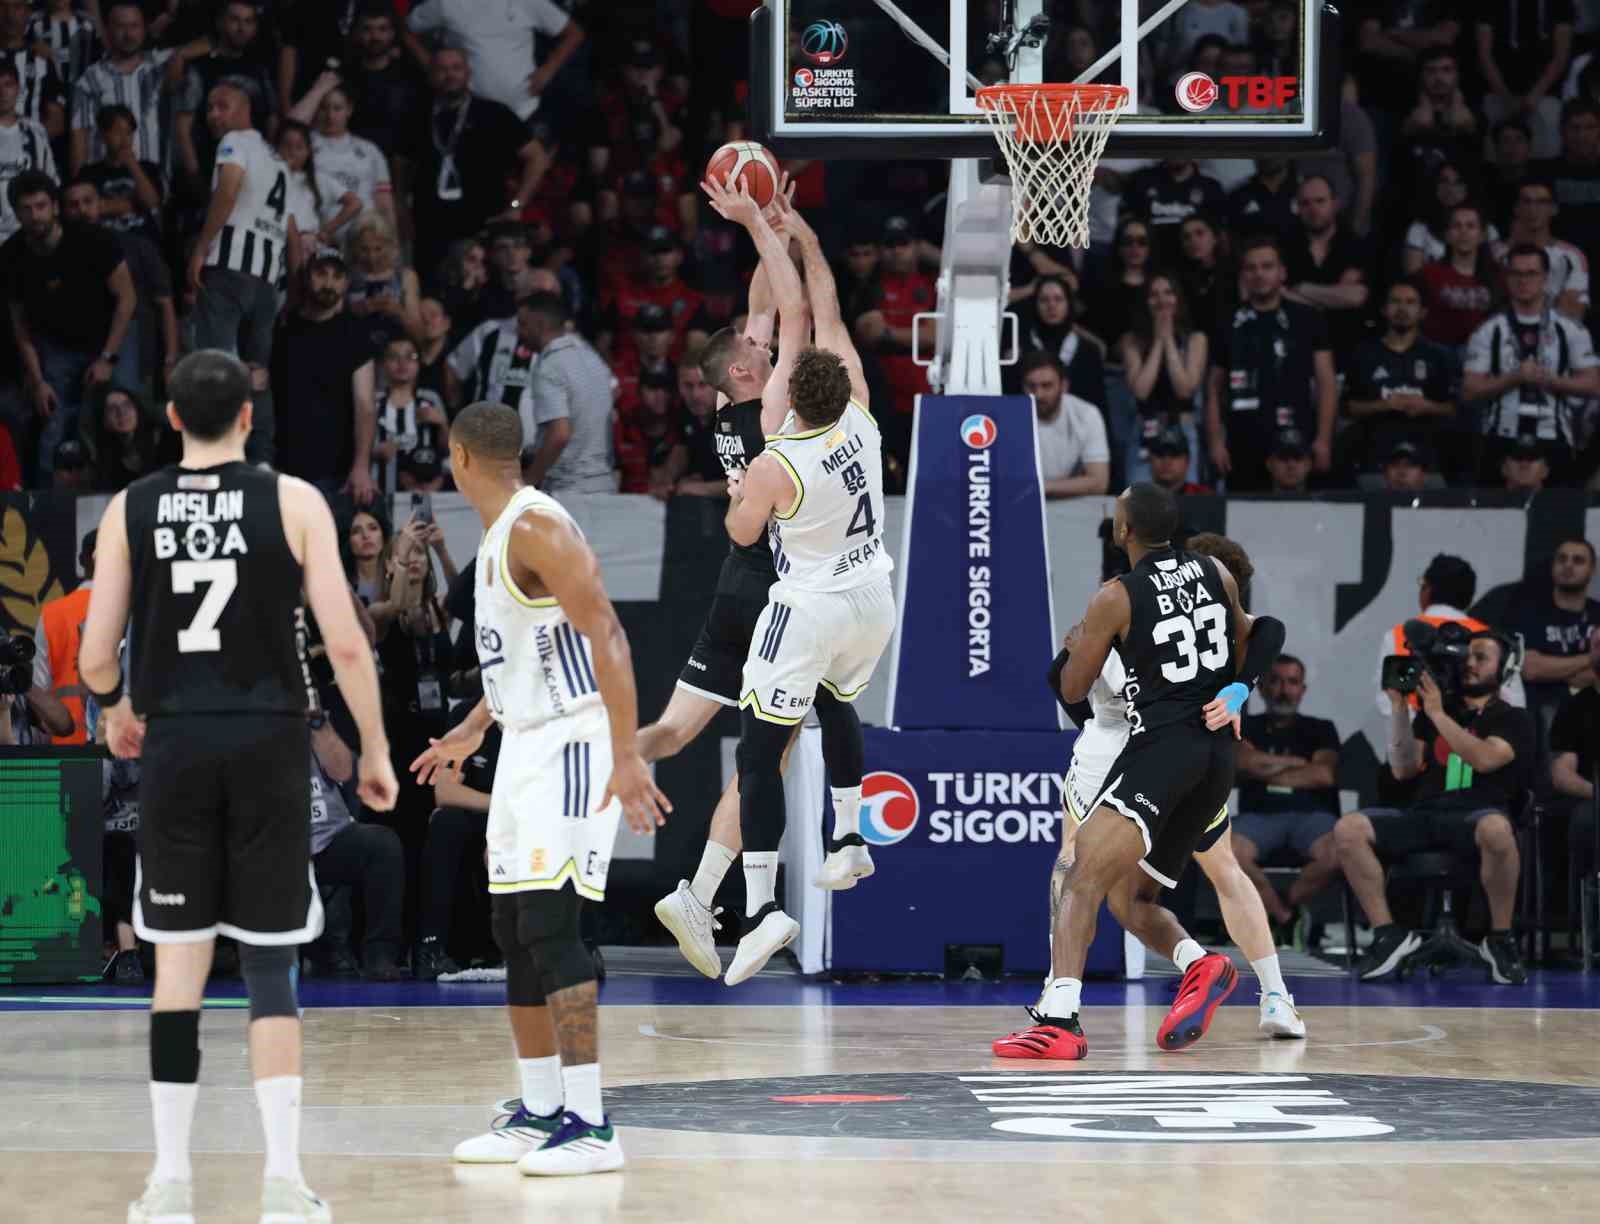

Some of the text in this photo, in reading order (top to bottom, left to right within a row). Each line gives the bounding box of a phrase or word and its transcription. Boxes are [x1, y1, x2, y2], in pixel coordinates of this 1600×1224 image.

[792, 87, 858, 97] BASKETBOL
[795, 96, 832, 108] SÜPER
[1220, 76, 1297, 111] TBF
[265, 170, 287, 223] 4
[821, 433, 863, 475] MELLI
[157, 490, 244, 524] ARSLAN
[846, 491, 876, 538] 4
[171, 559, 238, 653] 7
[1152, 602, 1230, 684] 33
[928, 772, 1067, 805] TÜRKİY
[928, 809, 1064, 844] SİGOR
